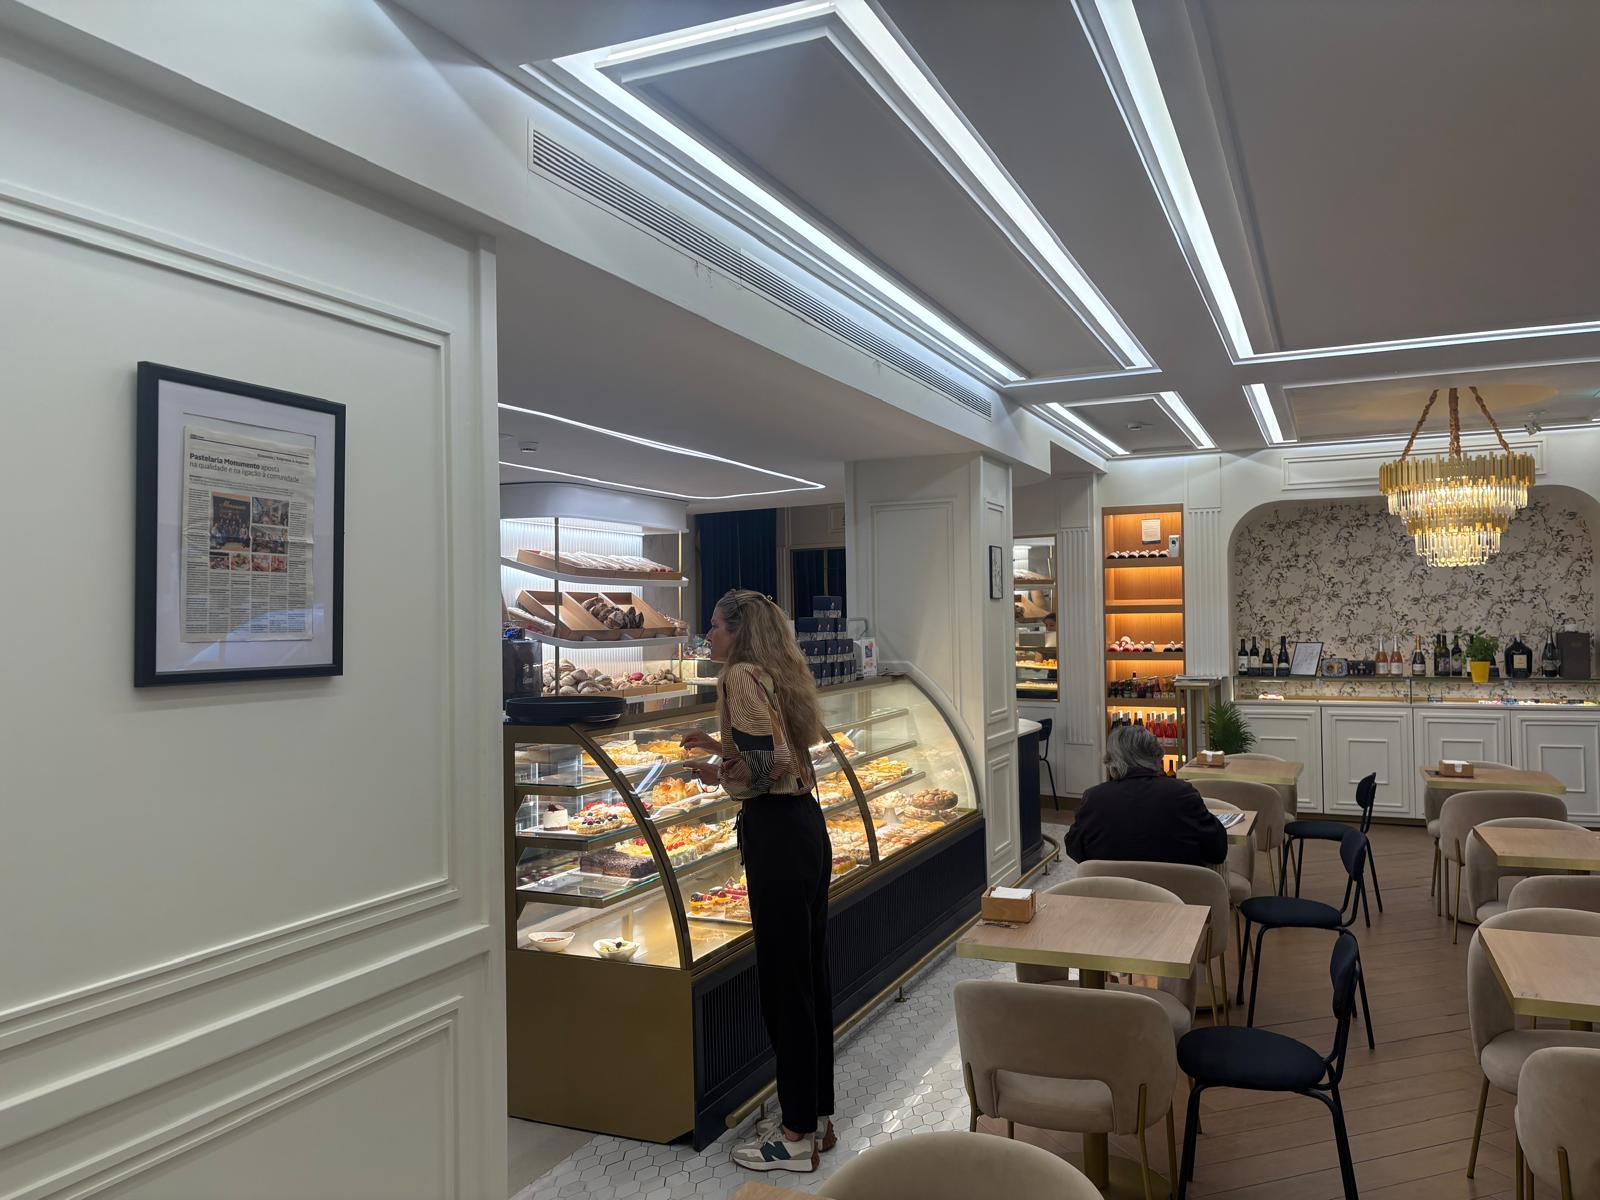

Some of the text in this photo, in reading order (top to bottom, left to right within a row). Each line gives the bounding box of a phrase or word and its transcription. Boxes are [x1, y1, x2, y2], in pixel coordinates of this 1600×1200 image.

[190, 453, 224, 464] Pastelaria
[224, 459, 260, 470] Monumento
[198, 463, 228, 472] qualidade
[267, 474, 300, 482] comunidade
